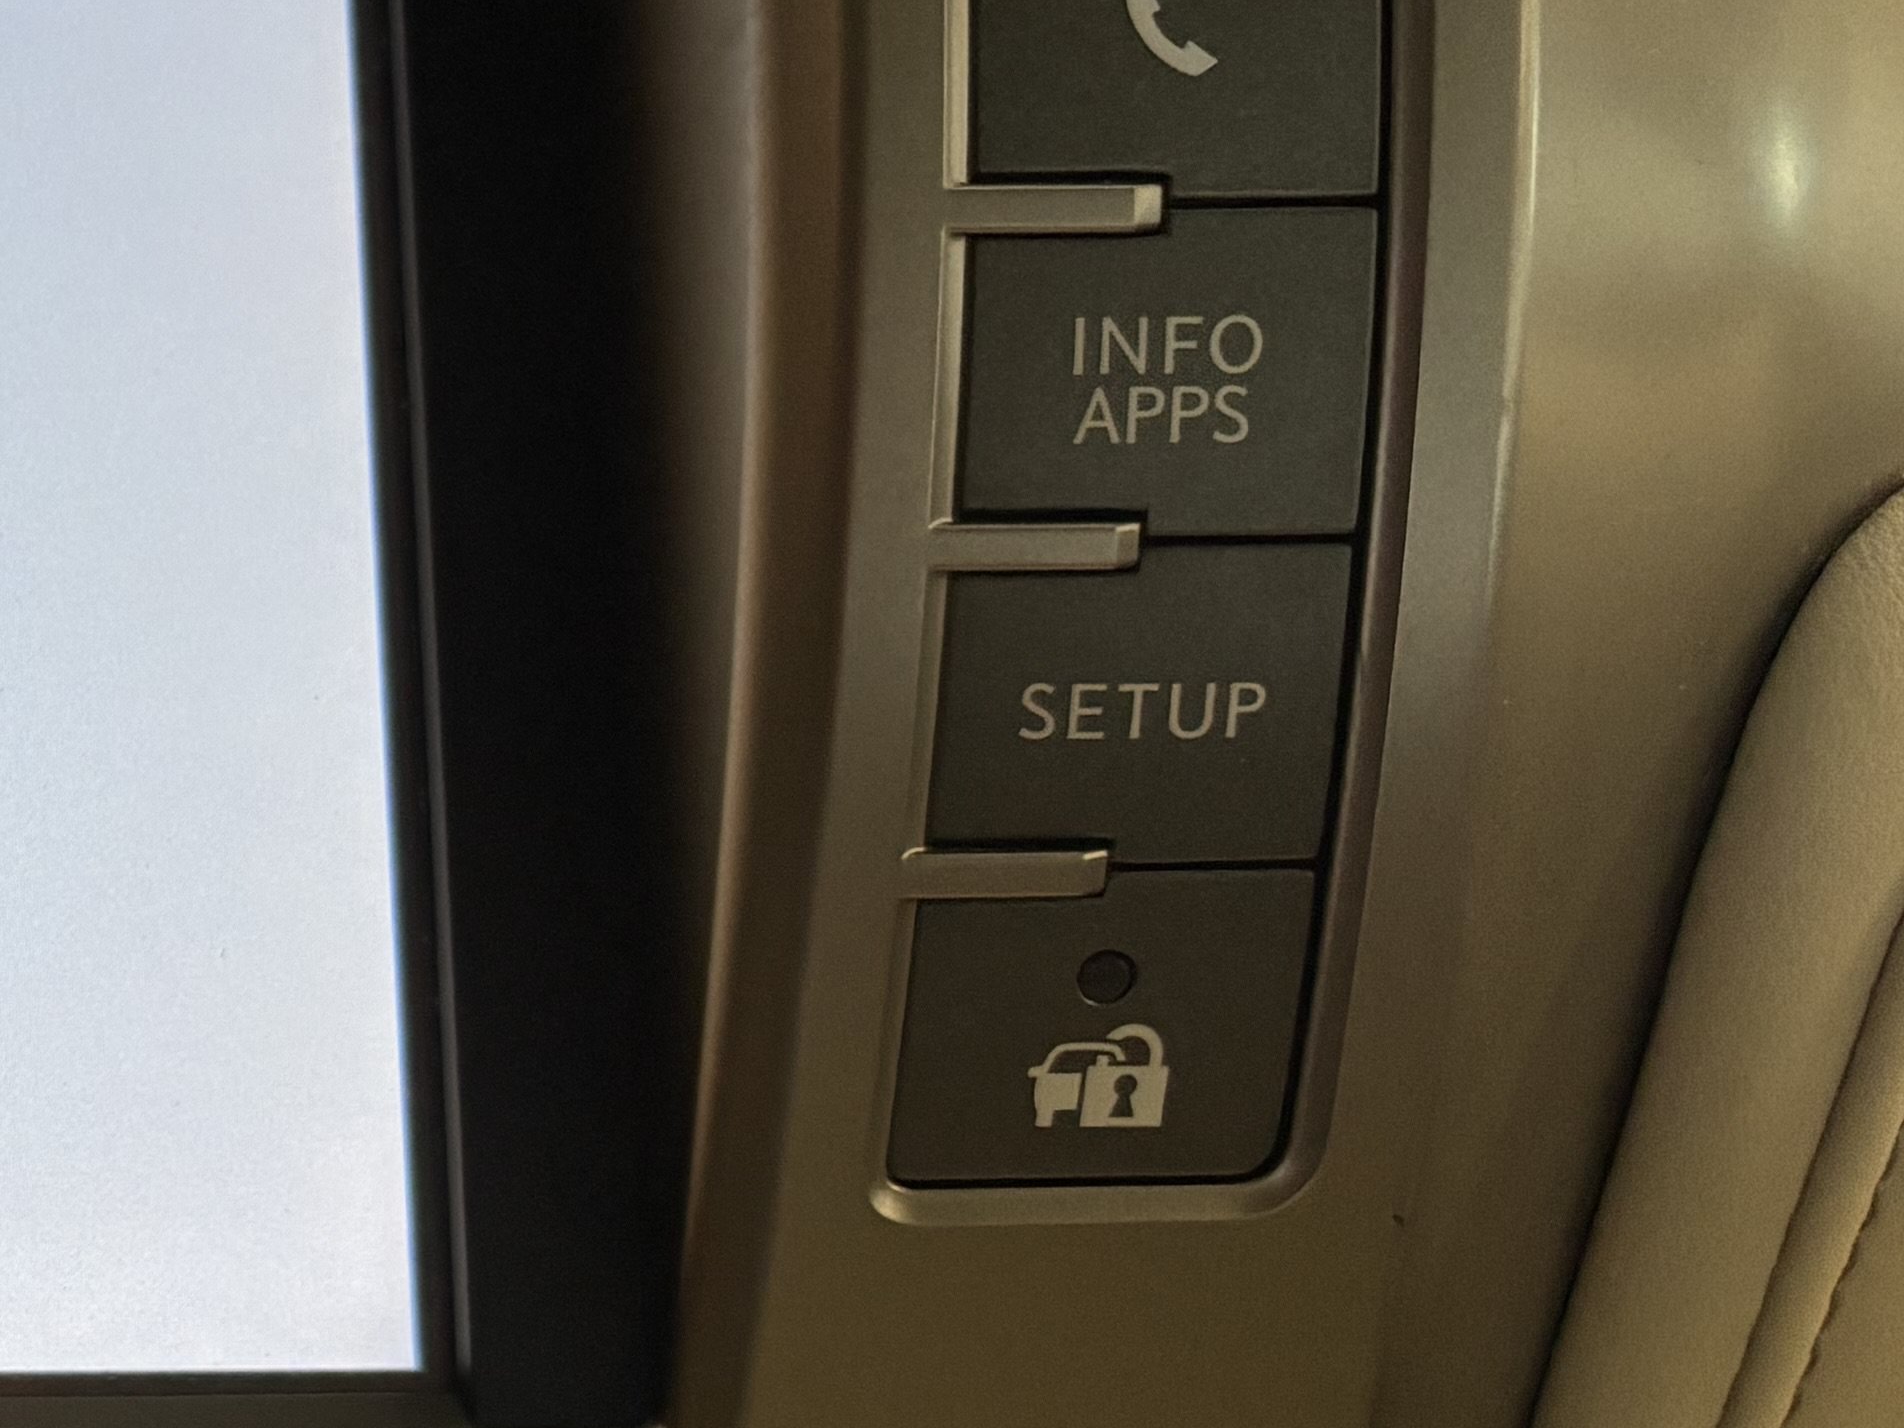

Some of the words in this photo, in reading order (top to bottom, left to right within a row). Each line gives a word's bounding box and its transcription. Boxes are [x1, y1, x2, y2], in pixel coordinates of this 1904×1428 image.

[1073, 313, 1263, 378] INFO
[1073, 386, 1250, 446] APPS
[1018, 681, 1268, 741] SETUP
